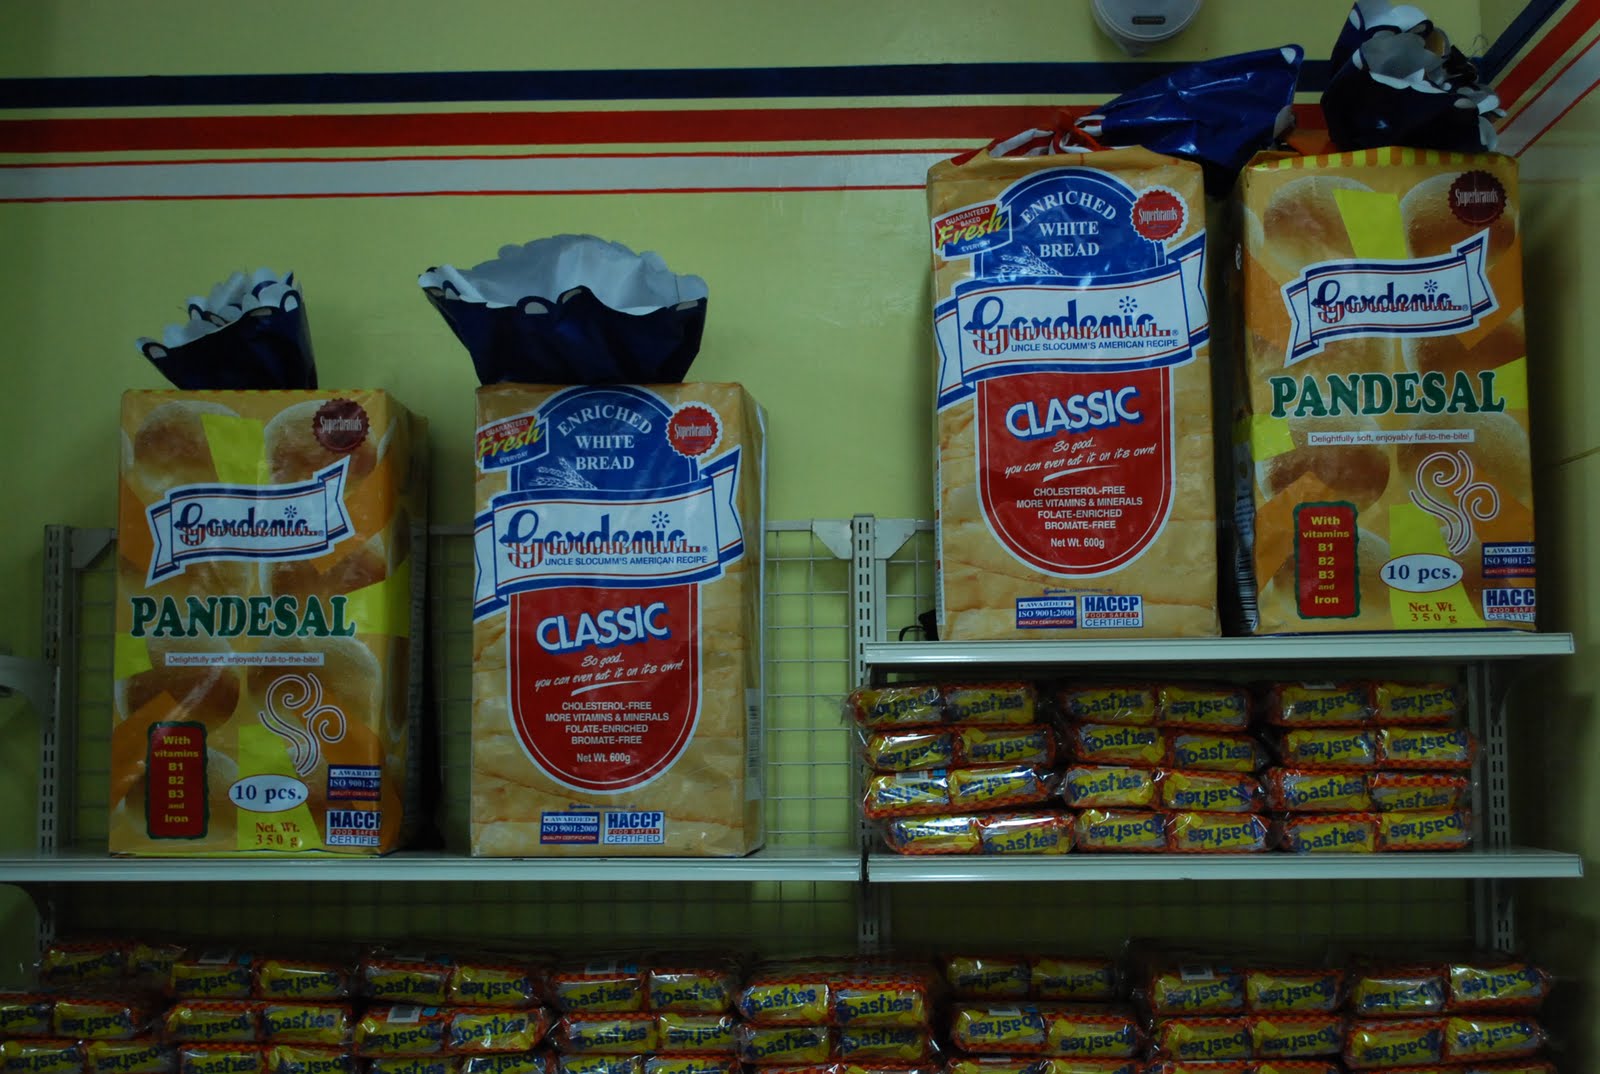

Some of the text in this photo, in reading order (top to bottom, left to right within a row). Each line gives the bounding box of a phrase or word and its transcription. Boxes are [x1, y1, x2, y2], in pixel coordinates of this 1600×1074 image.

[1454, 189, 1499, 207] Superbrands
[1019, 190, 1117, 225] ENRICHED
[946, 207, 990, 226] GUARANTEED
[960, 217, 981, 227] BAKED
[1138, 206, 1178, 225] Superbrands
[938, 205, 1008, 251] Fresh
[1039, 220, 1099, 237] WHITE
[1039, 242, 1100, 258] BREAD
[1311, 279, 1463, 323] Gardenia
[963, 296, 1171, 355] Gardenia
[1011, 339, 1178, 352] UNCLE SLOCUMM'S AMERICAN RECIPE
[1269, 371, 1505, 417] PANDESAL
[1005, 386, 1141, 438] CLASSIC
[319, 415, 363, 434] Superbrands
[485, 419, 528, 436] GUARANTEED
[556, 404, 652, 437] ENRICHED
[674, 423, 713, 440] Superbrands
[1311, 434, 1354, 443] Delightfully
[1376, 433, 1412, 443] enjoyably
[1415, 431, 1469, 441] full-to-the-bite!
[478, 417, 545, 462] Fresh
[574, 435, 635, 449] WHITE
[1052, 440, 1069, 453] So
[499, 450, 528, 464] EVERYDAY
[576, 455, 635, 470] BREAD
[1005, 466, 1021, 479] you
[1024, 462, 1041, 472] can
[1044, 459, 1065, 470] even
[1067, 455, 1083, 466] eat
[1086, 452, 1097, 464] it
[1099, 451, 1111, 462] on
[1133, 443, 1157, 457] own!
[1033, 486, 1125, 497] CHOLESTEROL-FREE
[1016, 497, 1143, 508] MORE VITAMINS & MINERALS
[1038, 509, 1122, 519] FOLATE-ENRICHED
[1311, 516, 1340, 525] With
[174, 503, 318, 546] Gardenia
[1045, 520, 1116, 530] BROMATE-FREE
[500, 510, 701, 568] Gardenia
[1302, 530, 1350, 538] vitamins
[1051, 537, 1105, 549] Net Wt. 600g
[1318, 543, 1334, 552] B1
[545, 555, 708, 566] UNCLE SLOCUMM'S AMERICAN RECIPE
[1318, 556, 1335, 566] B2
[1484, 557, 1500, 565] ISO
[1318, 570, 1335, 579] B3
[1387, 564, 1457, 584] 10 pcs.
[1085, 596, 1139, 611] HACCP
[1314, 595, 1339, 604] Iron
[1486, 589, 1535, 606] HACC
[1019, 609, 1074, 617] ISO 9001:2000
[1408, 602, 1457, 612] Net. Wt.
[130, 595, 356, 637] PANDESAL
[1085, 618, 1139, 626] CERTIFIED
[536, 602, 669, 651] CLASSIC
[168, 655, 209, 664] Delightfully
[228, 655, 264, 664] enjoyably
[581, 655, 598, 667] So
[534, 679, 550, 692] you
[554, 675, 570, 685] can
[573, 672, 592, 683] even
[595, 669, 611, 681] eat
[614, 666, 624, 678] it
[627, 666, 639, 676] on
[661, 659, 684, 673] own!
[562, 701, 652, 711] CHOLESTEROL-FREE
[545, 712, 669, 722] MORE VITAMINS & MINERALS
[565, 724, 648, 733] FOLATE-ENRICHED
[162, 736, 191, 745] With
[571, 736, 642, 744] BROMATE-FREE
[1300, 732, 1375, 759] Toasties
[1392, 730, 1468, 755] Toasties
[154, 749, 199, 758] vitamins
[576, 752, 631, 764] Net Wt. 600g
[168, 762, 184, 771] B1
[168, 776, 184, 785] B2
[330, 779, 346, 787] ISO
[1069, 767, 1143, 801] Toasties
[168, 789, 184, 798] B3
[235, 785, 302, 804] 10 pcs.
[1175, 784, 1252, 807] Toasties
[164, 814, 189, 823] Iron
[608, 813, 661, 828] HACCP
[1390, 812, 1463, 839] Toasties
[255, 822, 300, 833] Net. Wt.
[559, 825, 598, 833] 9001:2000
[1089, 814, 1166, 842] Toasties
[1188, 817, 1265, 846] Toasties
[329, 836, 380, 844] CERTIFIE
[607, 835, 660, 843] CERTIFIED
[742, 986, 817, 1016] Toasties
[1061, 1024, 1137, 1052] Toasties
